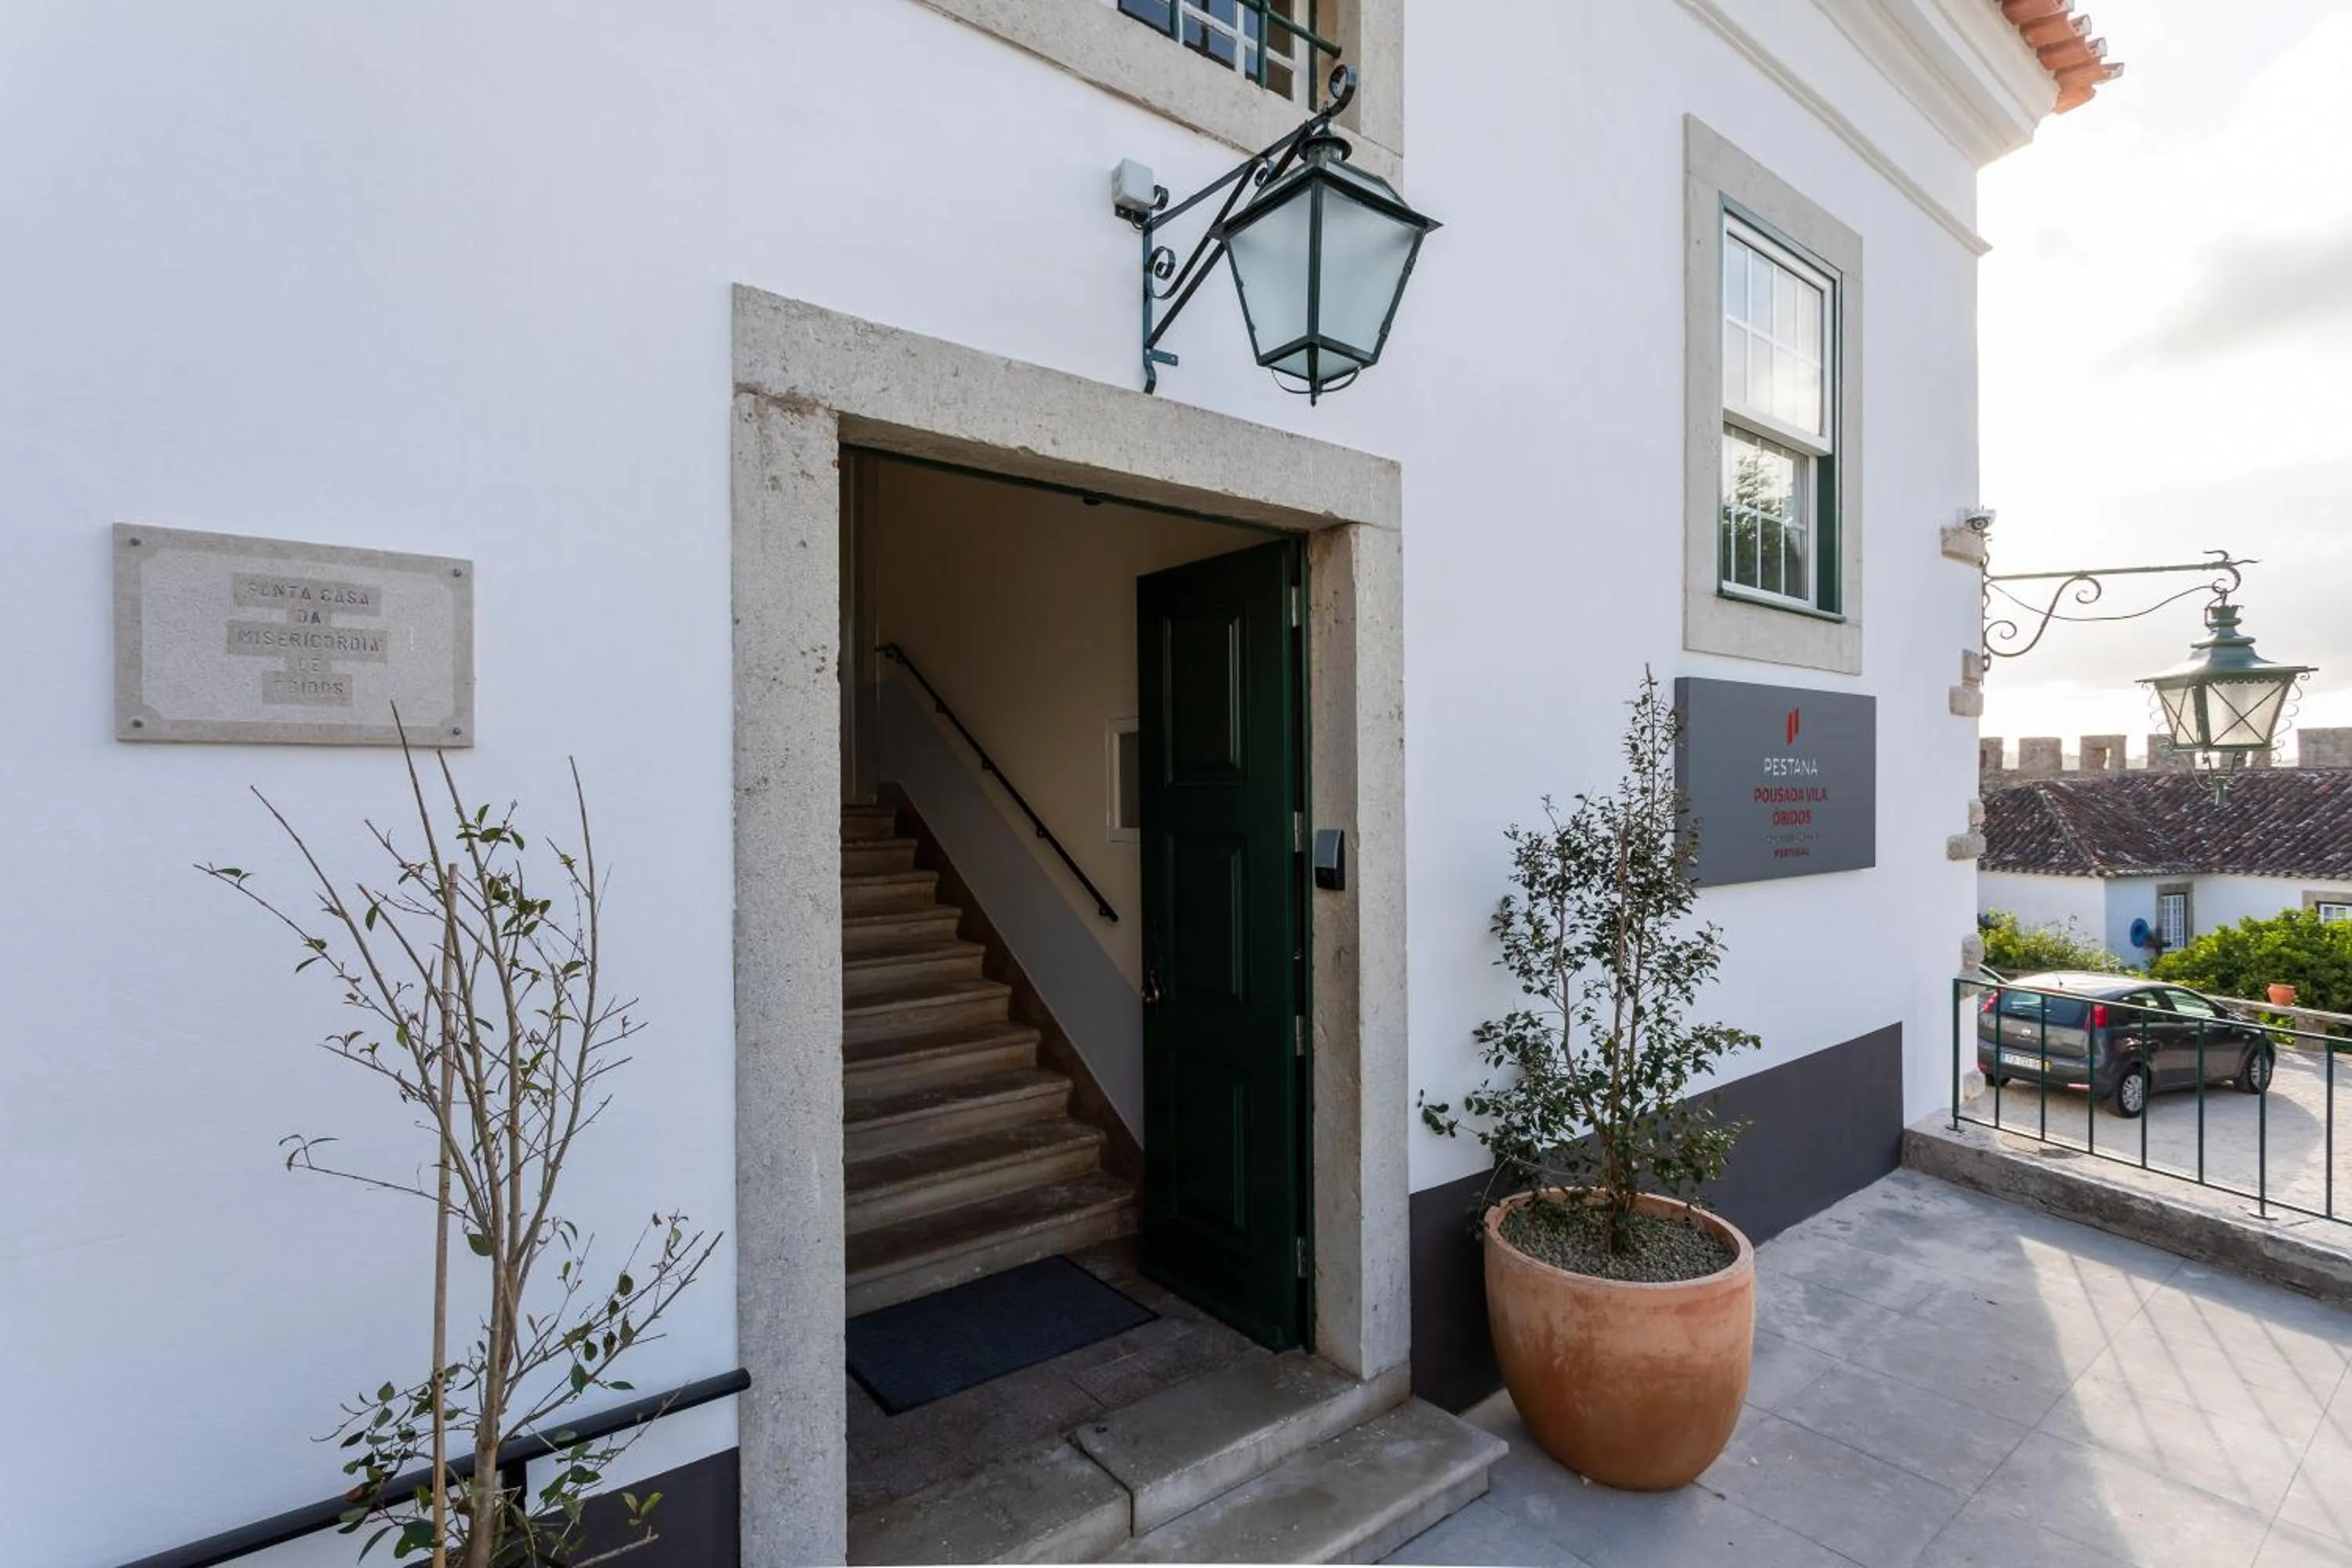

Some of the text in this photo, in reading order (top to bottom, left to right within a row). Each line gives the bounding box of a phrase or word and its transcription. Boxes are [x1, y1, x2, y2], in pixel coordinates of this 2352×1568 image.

[1764, 757, 1818, 776] PESTANA
[1754, 787, 1828, 804] POUSADA VILA
